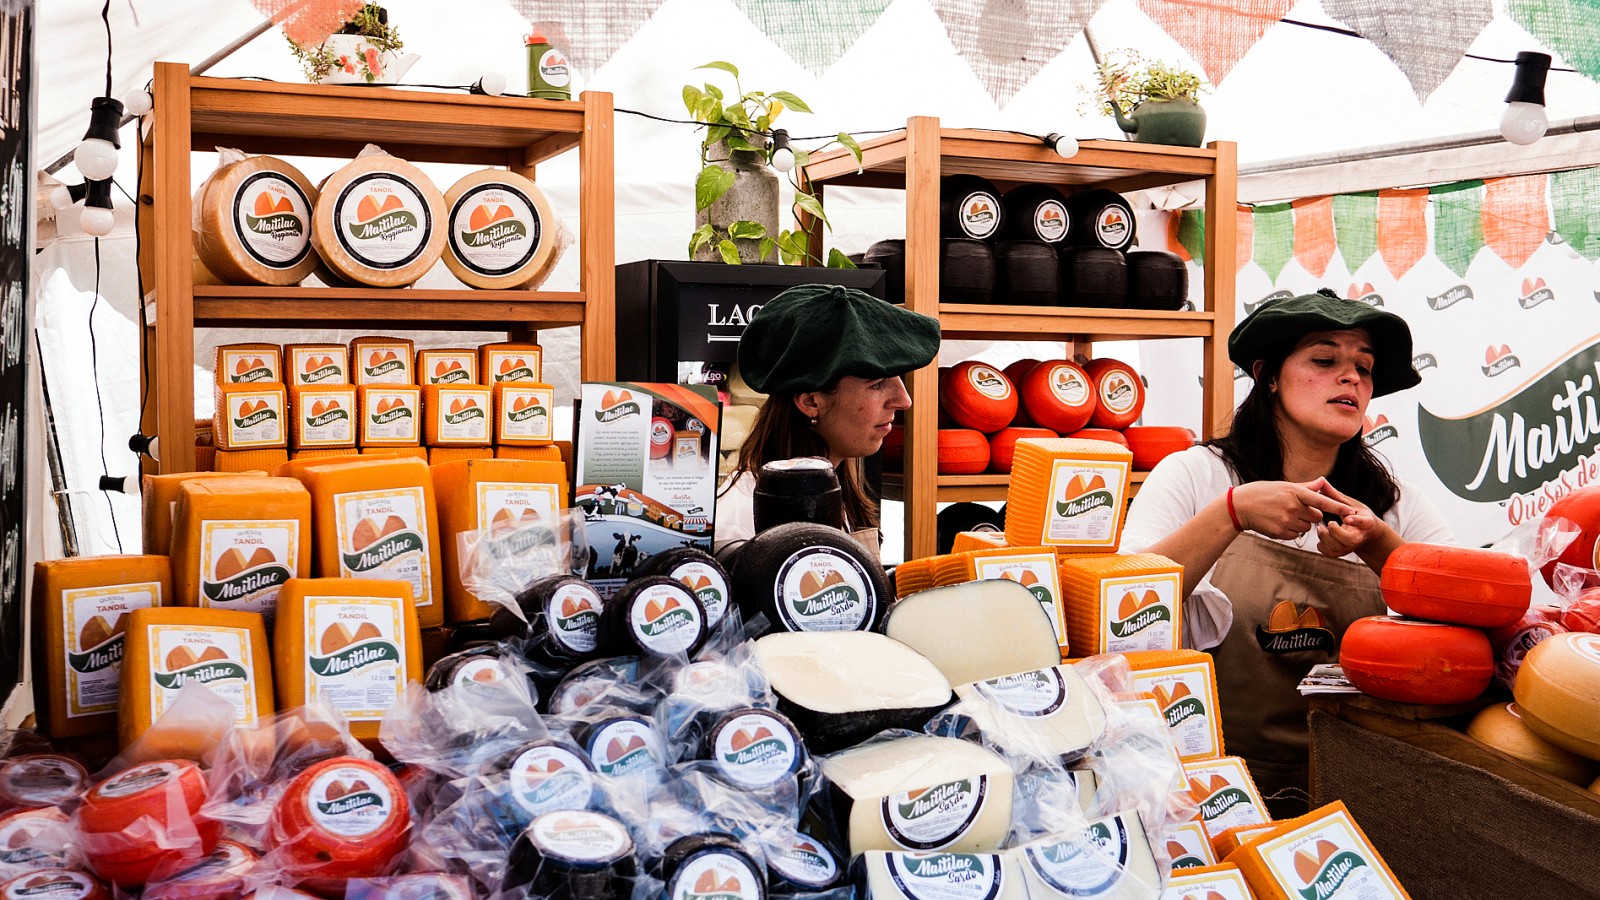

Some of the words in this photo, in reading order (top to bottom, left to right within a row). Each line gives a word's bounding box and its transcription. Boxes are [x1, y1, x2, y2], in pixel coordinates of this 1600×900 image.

[267, 185, 288, 195] TANDIL
[253, 217, 295, 231] Maitilac
[358, 216, 408, 238] Maitilac
[470, 225, 518, 246] Maitilac
[306, 368, 337, 382] Maitilac
[370, 362, 400, 376] Maitilac
[240, 412, 271, 428] Maitilac
[312, 412, 343, 427] Maitilac
[376, 410, 407, 424] Maitilac
[449, 410, 479, 424] Maitilac
[513, 408, 542, 422] Maitilac
[599, 405, 635, 422] Maitilac
[1508, 474, 1574, 526] Quesos
[1578, 458, 1599, 488] de
[1062, 494, 1108, 516] Maitilac
[354, 539, 412, 570] Maitilac
[213, 572, 279, 600] Maitilac
[96, 603, 128, 613] TANDIL
[830, 601, 854, 616] Sardo
[648, 612, 687, 636] Maitilac
[1118, 609, 1163, 637] Maitilac
[1265, 633, 1324, 650] Maitilac
[81, 643, 123, 671] Maiti
[320, 646, 388, 675] Maitilac
[1167, 703, 1196, 726] itilac
[734, 742, 778, 764] Maitilac
[325, 796, 374, 814] Maitilac
[907, 782, 962, 819] Maitilac
[938, 793, 965, 814] Sardo
[1201, 792, 1240, 820] Maitilac
[913, 853, 973, 876] Maitilac
[948, 868, 977, 884] Sardo
[1314, 857, 1353, 898] Maitilac
